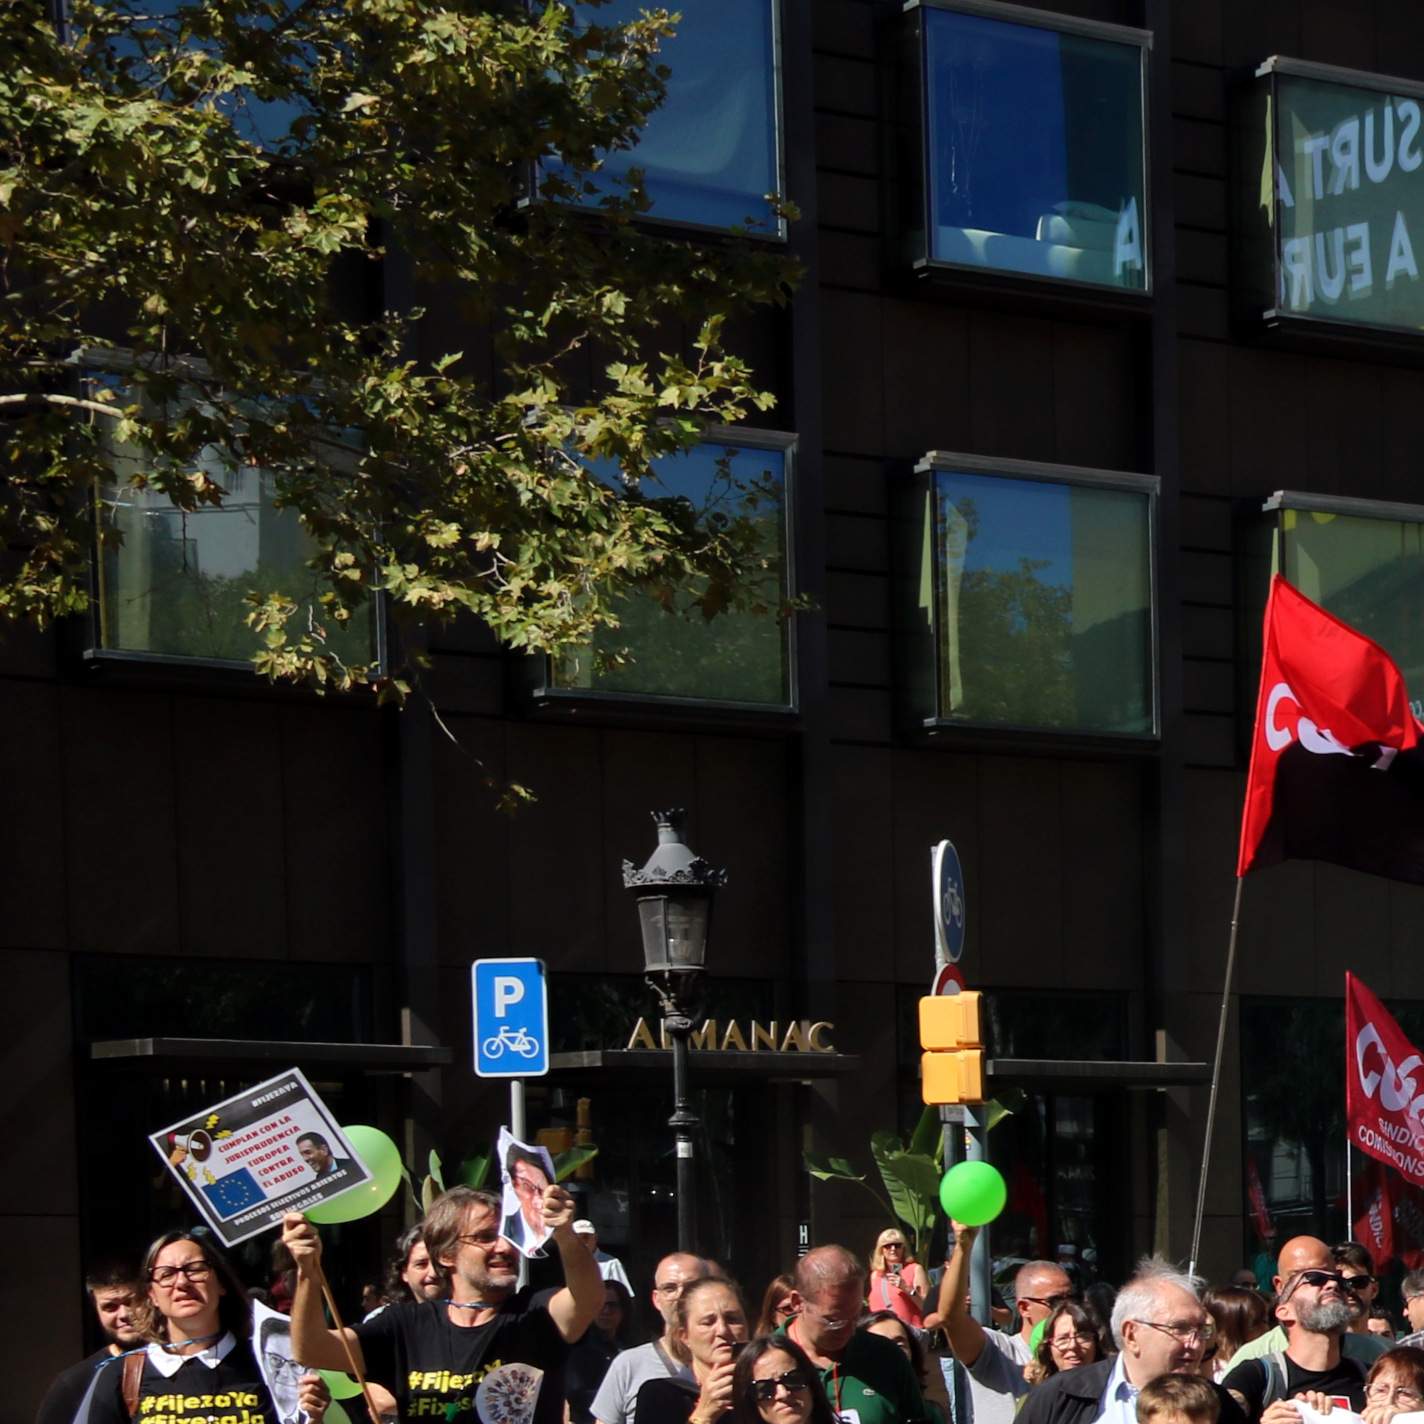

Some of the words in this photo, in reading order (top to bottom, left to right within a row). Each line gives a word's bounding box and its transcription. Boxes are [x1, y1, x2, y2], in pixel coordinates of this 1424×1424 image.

[493, 976, 525, 1018] P
[217, 1127, 259, 1153] CUMPLAN
[259, 1120, 278, 1135] CON
[278, 1114, 292, 1126] LA
[224, 1125, 302, 1166] JURISPRUDENCIA
[248, 1144, 291, 1168] EUROPEA
[257, 1155, 296, 1177] CONTRA
[261, 1179, 274, 1190] EL
[272, 1165, 306, 1184] ABUSO
